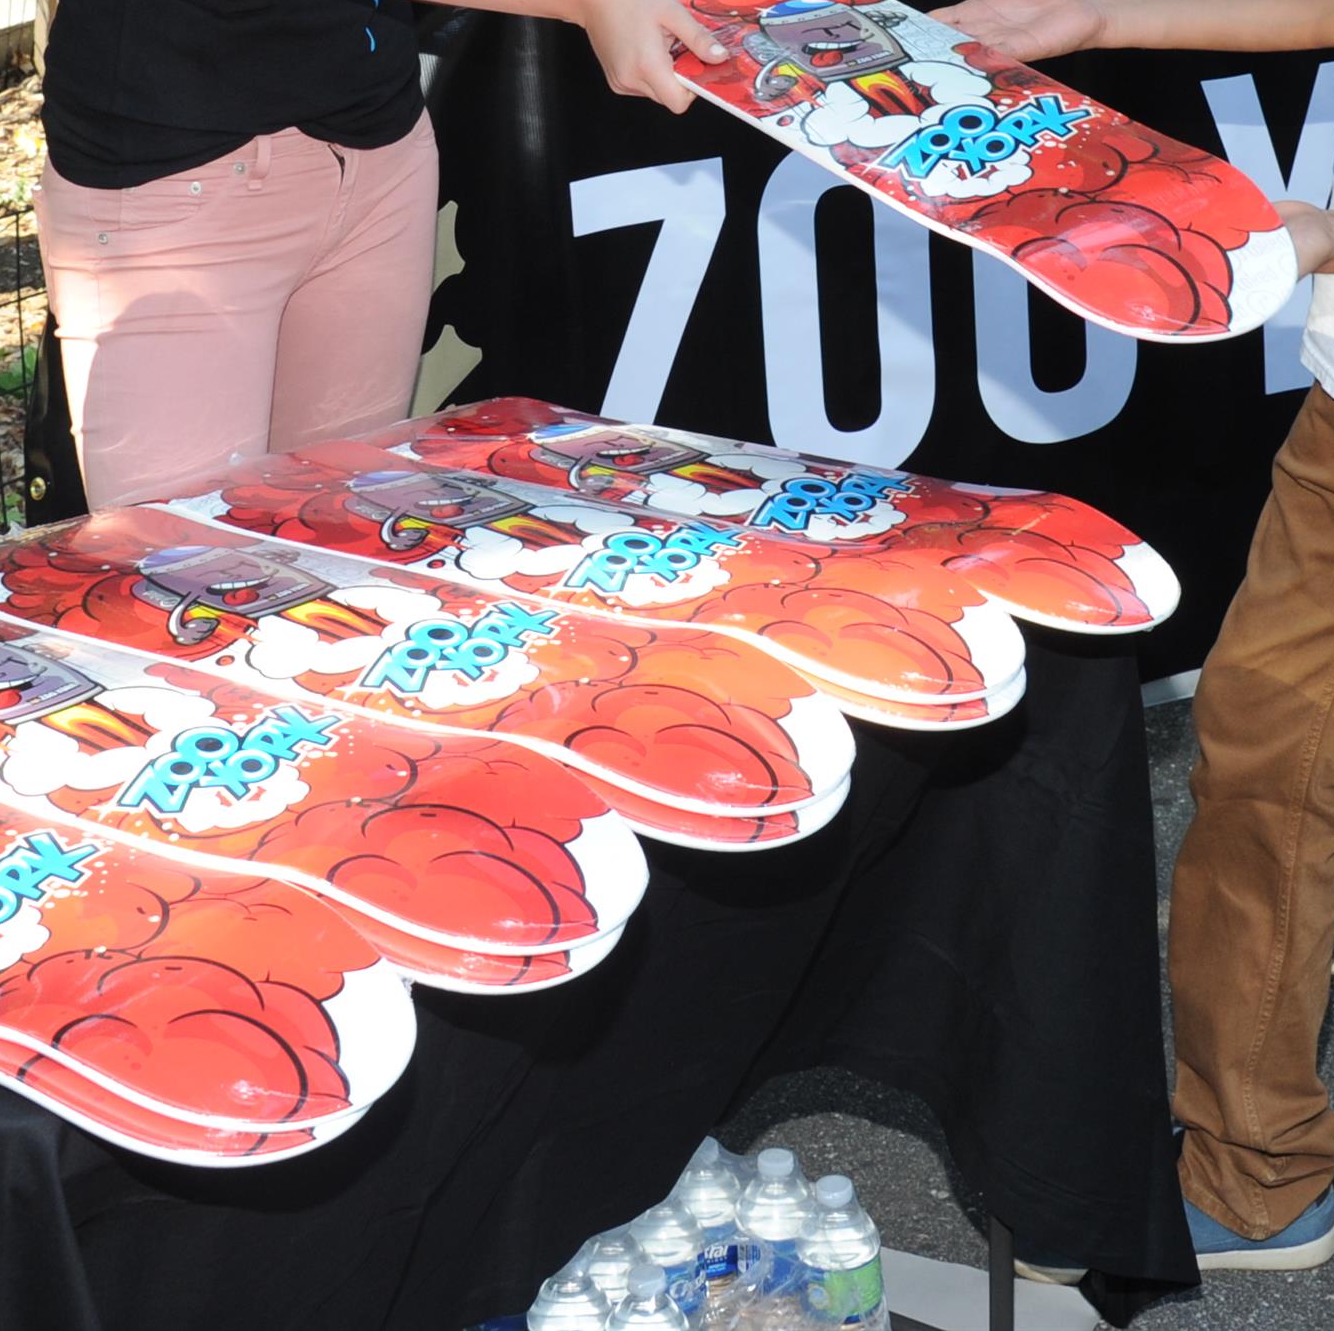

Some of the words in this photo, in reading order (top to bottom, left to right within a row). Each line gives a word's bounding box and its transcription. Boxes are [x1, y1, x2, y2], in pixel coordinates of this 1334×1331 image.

[878, 105, 999, 180] ZOO
[948, 95, 1093, 177] YORK
[749, 476, 837, 531] ZOO
[815, 470, 913, 523] YORK
[564, 531, 663, 593] ZOO
[633, 520, 747, 583] YORK
[359, 618, 469, 693] ZOO
[434, 601, 560, 682] YORK
[117, 726, 240, 813] ZOO
[199, 705, 342, 801] YORK
